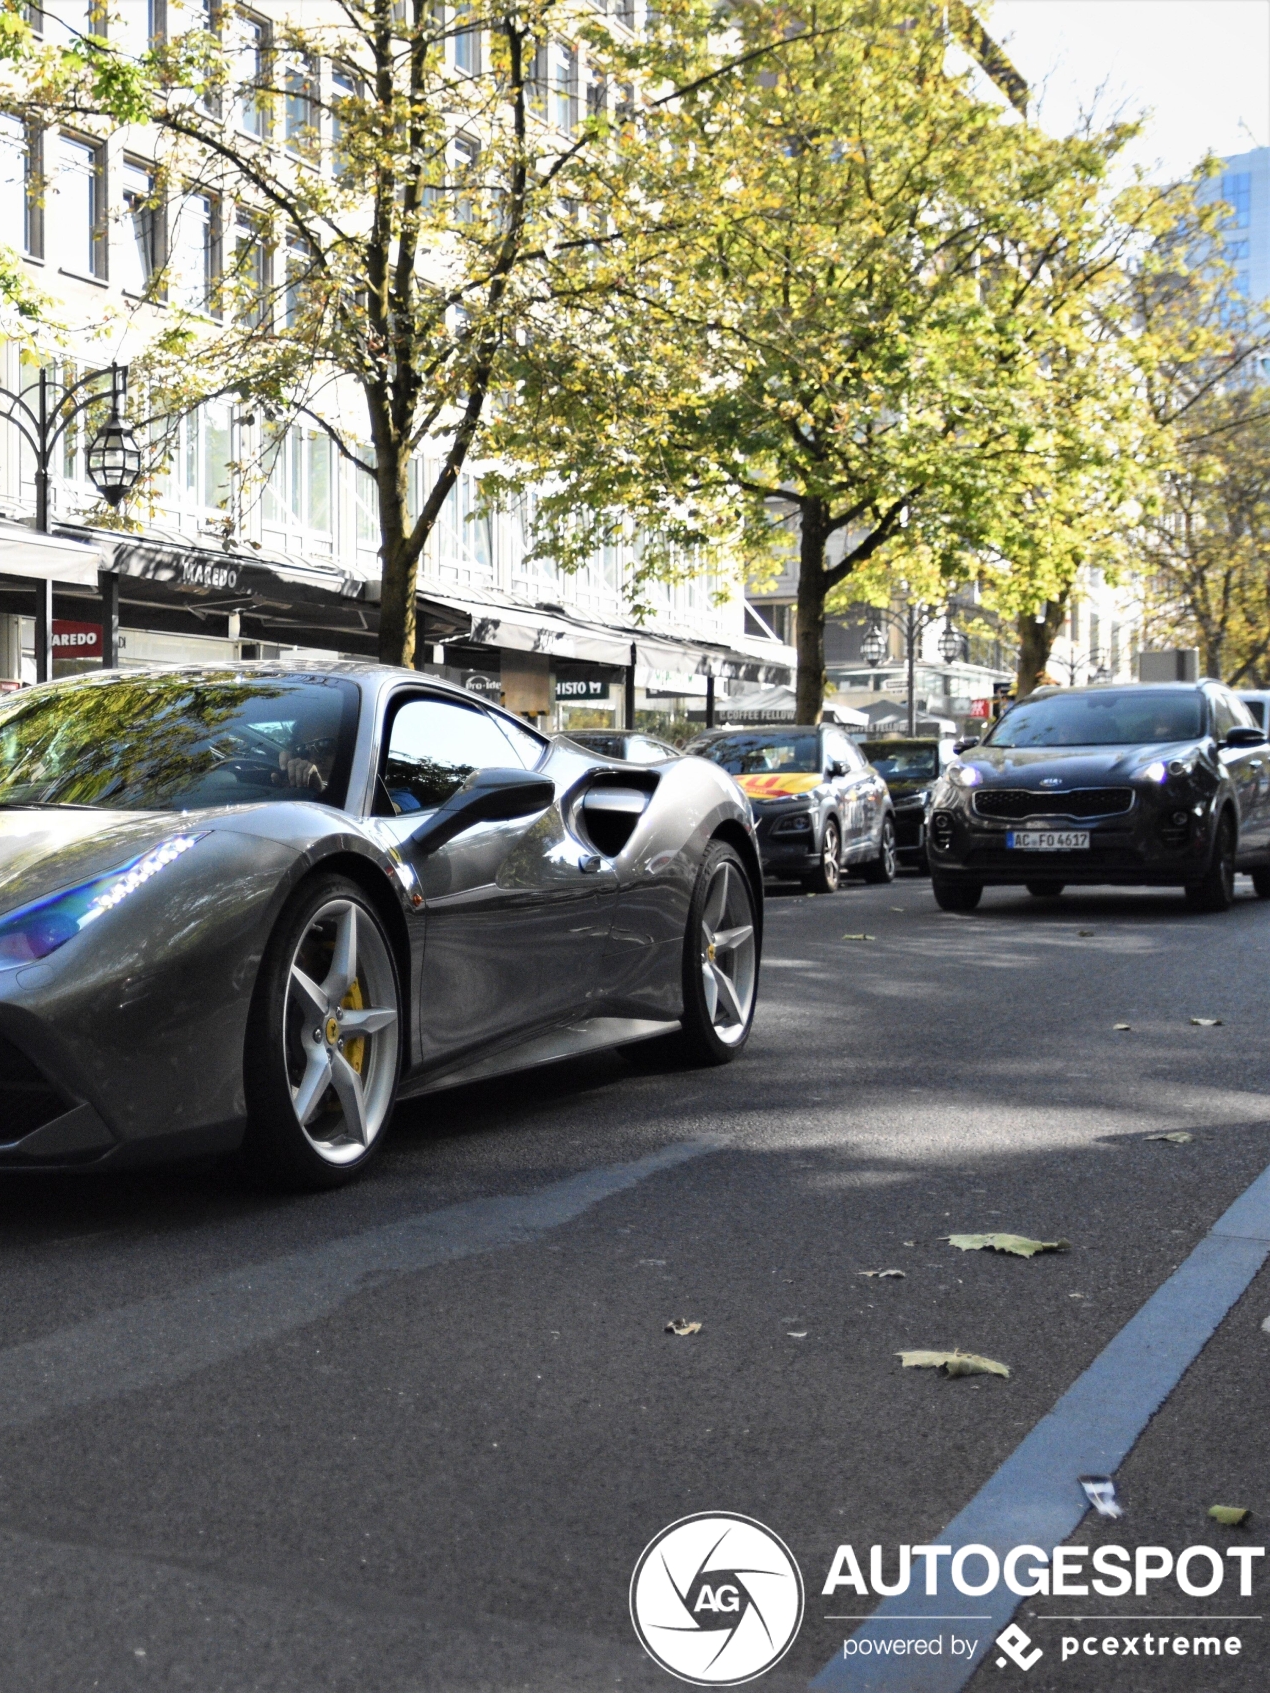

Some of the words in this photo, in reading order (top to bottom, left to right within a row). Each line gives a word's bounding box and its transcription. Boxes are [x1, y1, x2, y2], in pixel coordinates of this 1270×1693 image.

[182, 556, 237, 588] MAREDO
[51, 632, 98, 647] AREDO
[727, 710, 759, 720] COFFEE
[1015, 834, 1030, 846] AC
[1057, 834, 1087, 846] 4617
